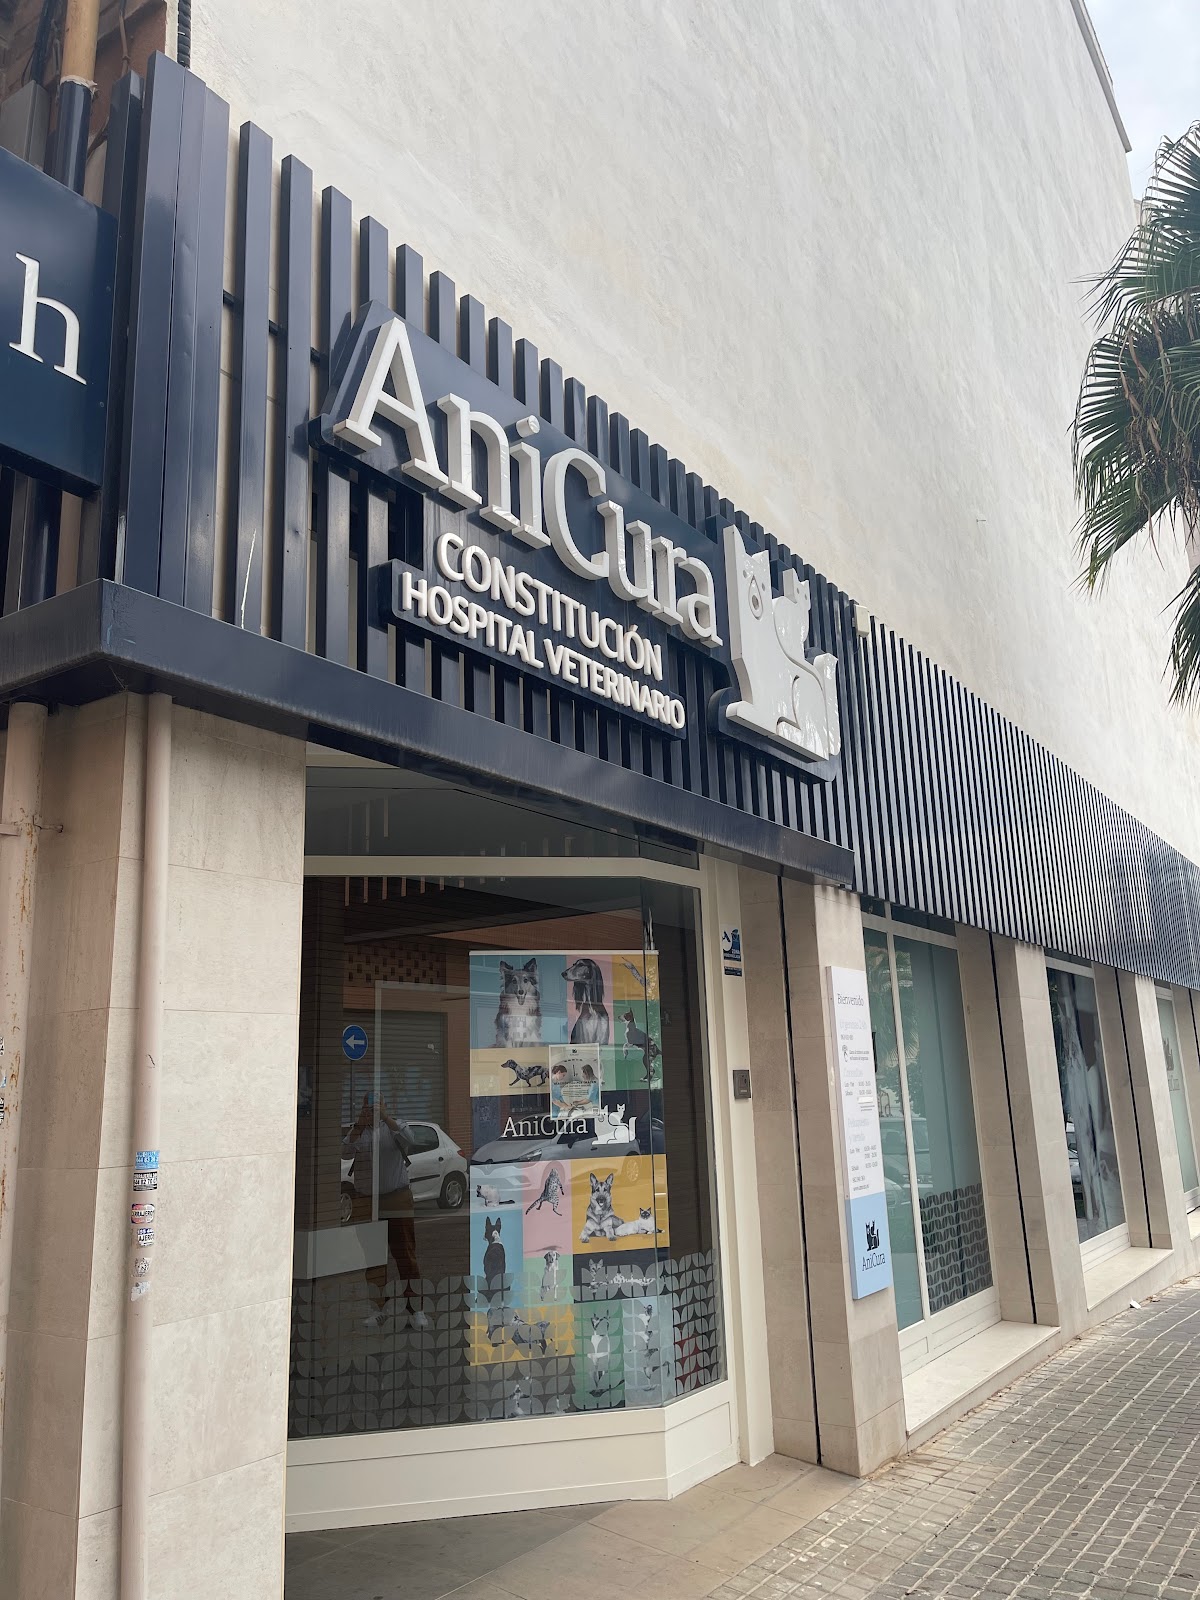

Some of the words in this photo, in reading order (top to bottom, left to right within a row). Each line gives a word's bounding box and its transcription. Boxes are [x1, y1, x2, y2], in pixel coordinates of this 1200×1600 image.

[9, 252, 87, 385] h
[333, 317, 723, 648] AniCura
[402, 571, 544, 669] HOSPITAL
[543, 638, 685, 729] VETERINARIO
[437, 532, 663, 681] CONSTITUCIÓN
[500, 1115, 589, 1138] AniCura
[862, 1252, 886, 1271] AniCura
